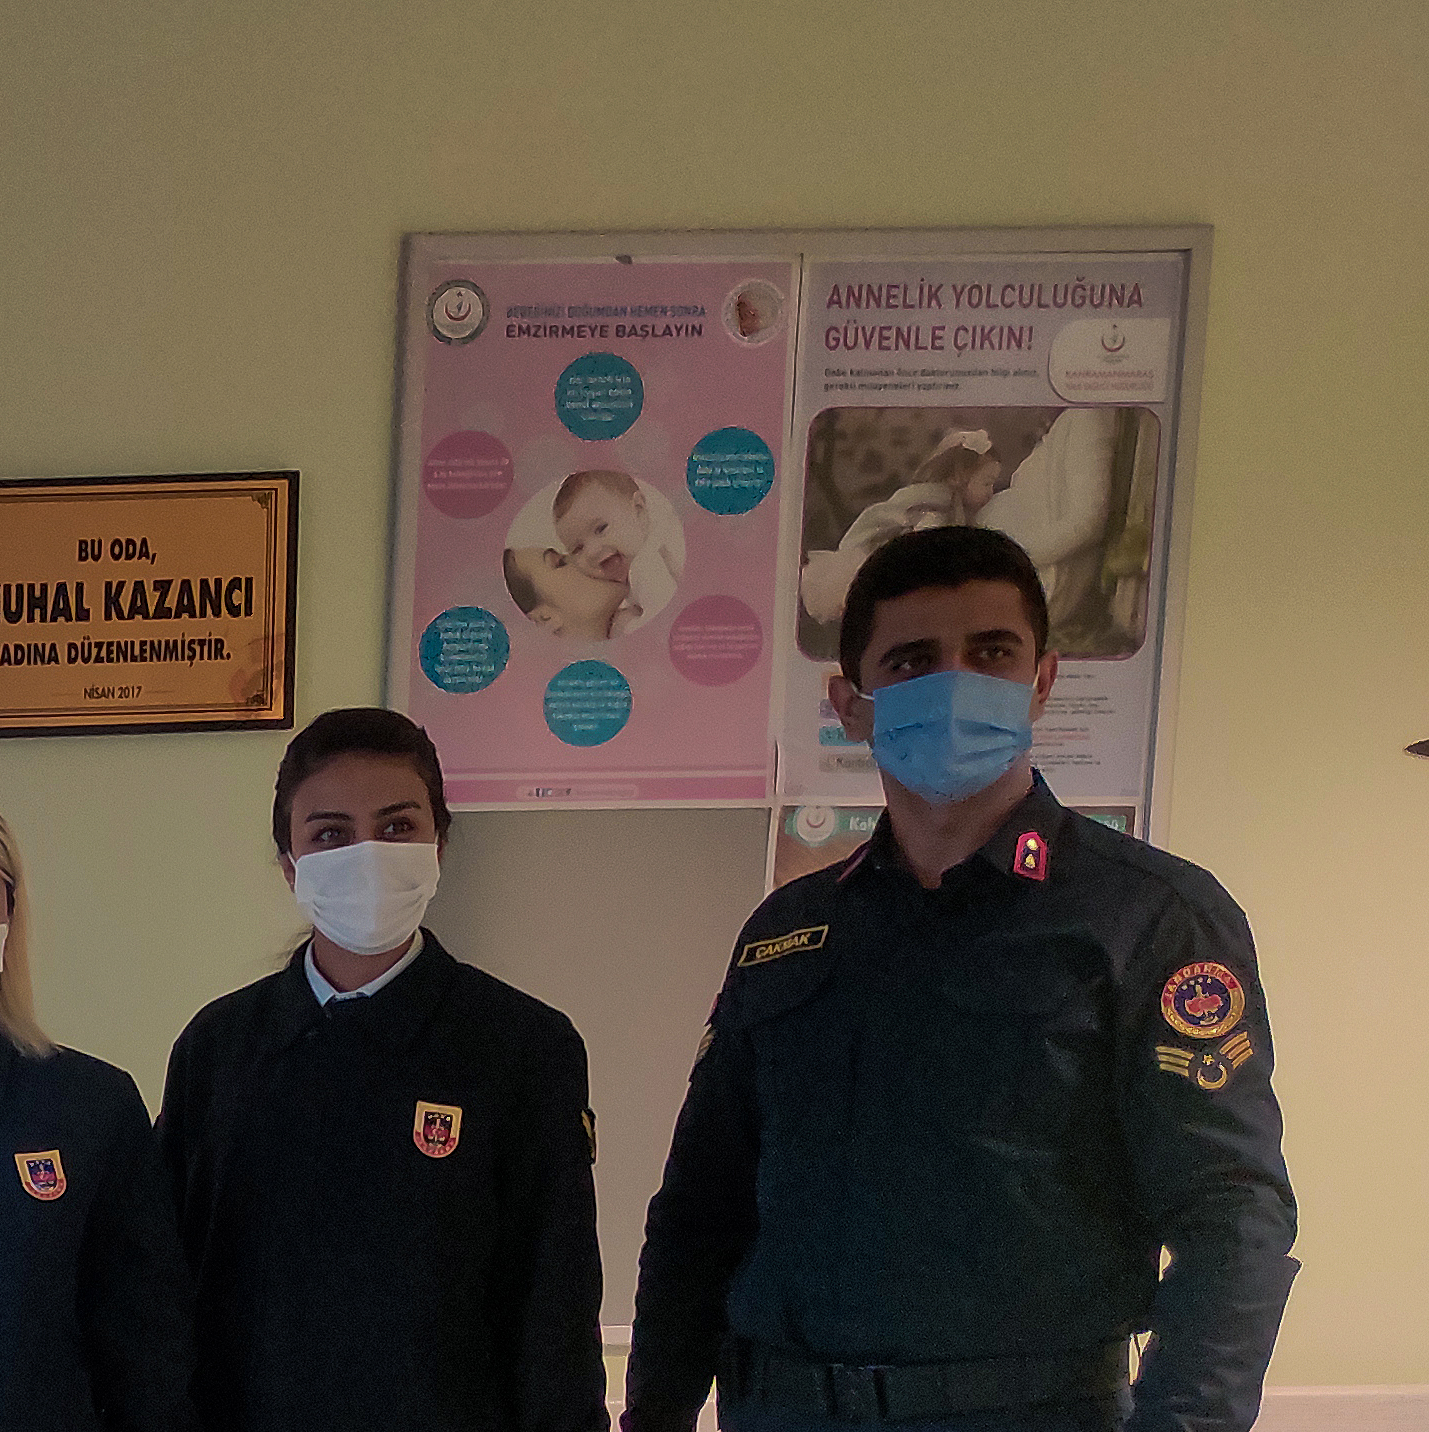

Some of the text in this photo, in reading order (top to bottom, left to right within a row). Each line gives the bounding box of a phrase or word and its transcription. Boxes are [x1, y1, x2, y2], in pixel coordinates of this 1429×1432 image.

[825, 276, 1144, 310] ANNELİK YOLCULUĞUNA
[505, 322, 704, 341] EMZİRMEYE BAŞLAYIN
[824, 319, 1035, 358] GÜVENLE ÇIKIN!
[77, 536, 158, 566] BU ODA,
[103, 575, 255, 622] KAZANCI
[66, 630, 232, 668] DÜZENLENMİŞTİR.
[82, 683, 143, 701] NİSAN 2017
